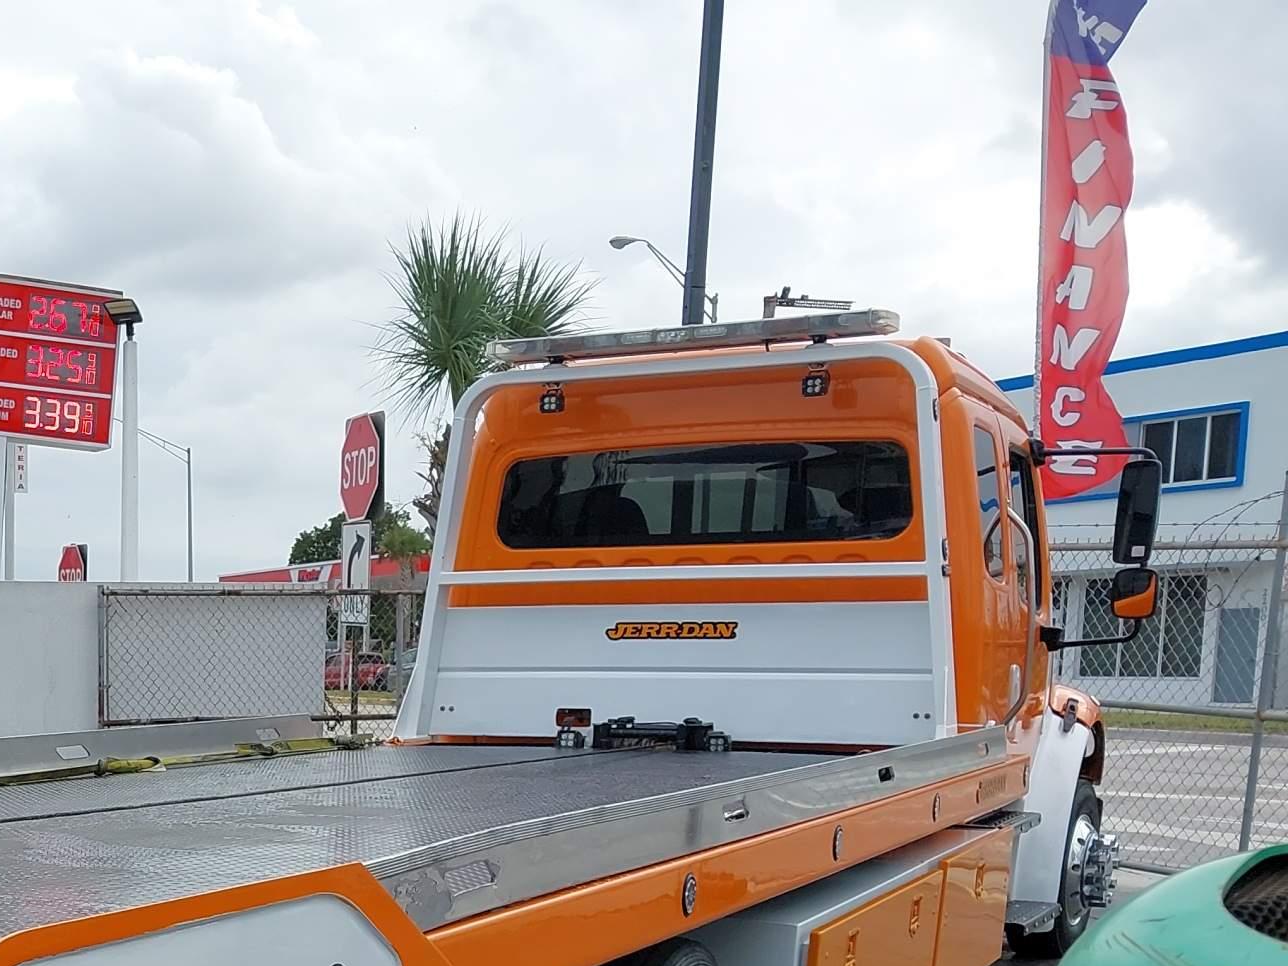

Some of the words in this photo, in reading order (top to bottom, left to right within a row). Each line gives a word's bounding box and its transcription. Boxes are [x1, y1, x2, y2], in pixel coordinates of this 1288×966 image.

[1049, 78, 1122, 477] FINANCE
[24, 396, 81, 434] 3.39
[342, 446, 377, 489] STOP
[343, 594, 367, 616] ONLY
[606, 622, 738, 640] JERR-DAN
